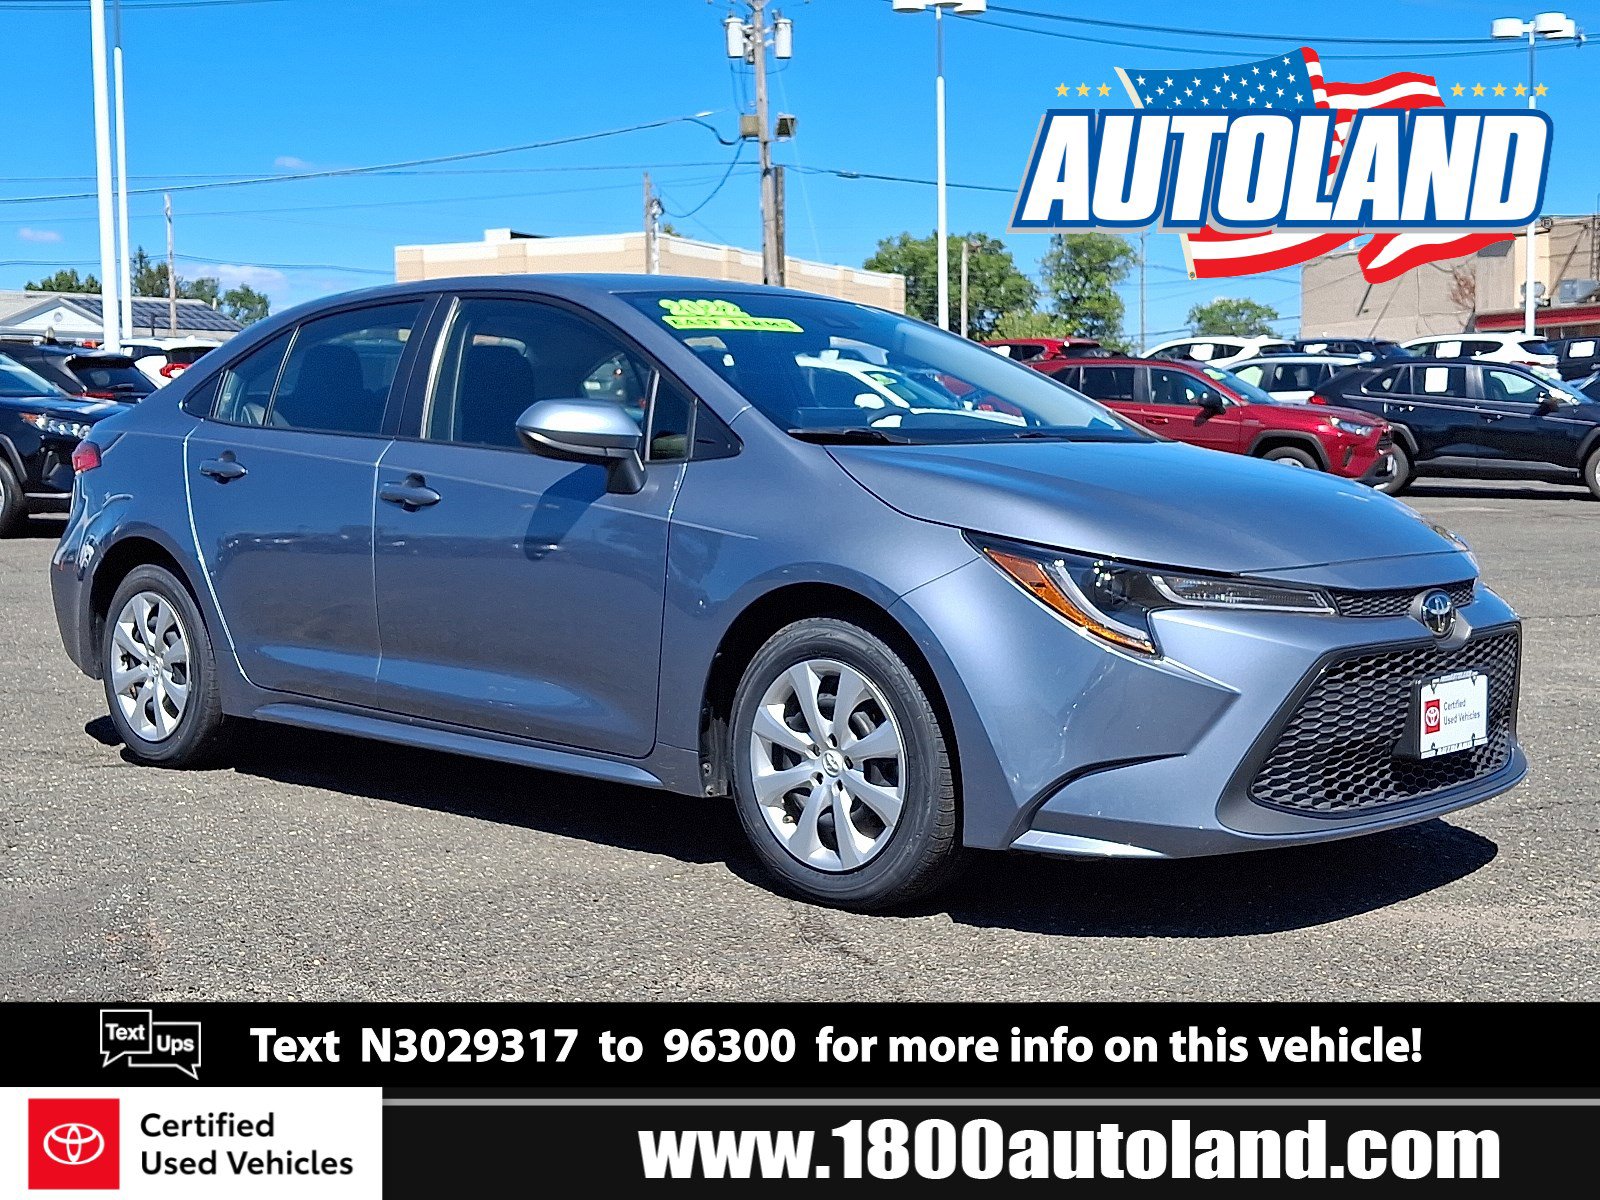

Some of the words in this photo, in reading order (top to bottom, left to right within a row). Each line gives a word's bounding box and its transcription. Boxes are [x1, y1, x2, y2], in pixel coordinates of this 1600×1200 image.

[1443, 699, 1467, 711] Certified
[1443, 714, 1458, 726] Used
[1458, 711, 1481, 723] Vehicles
